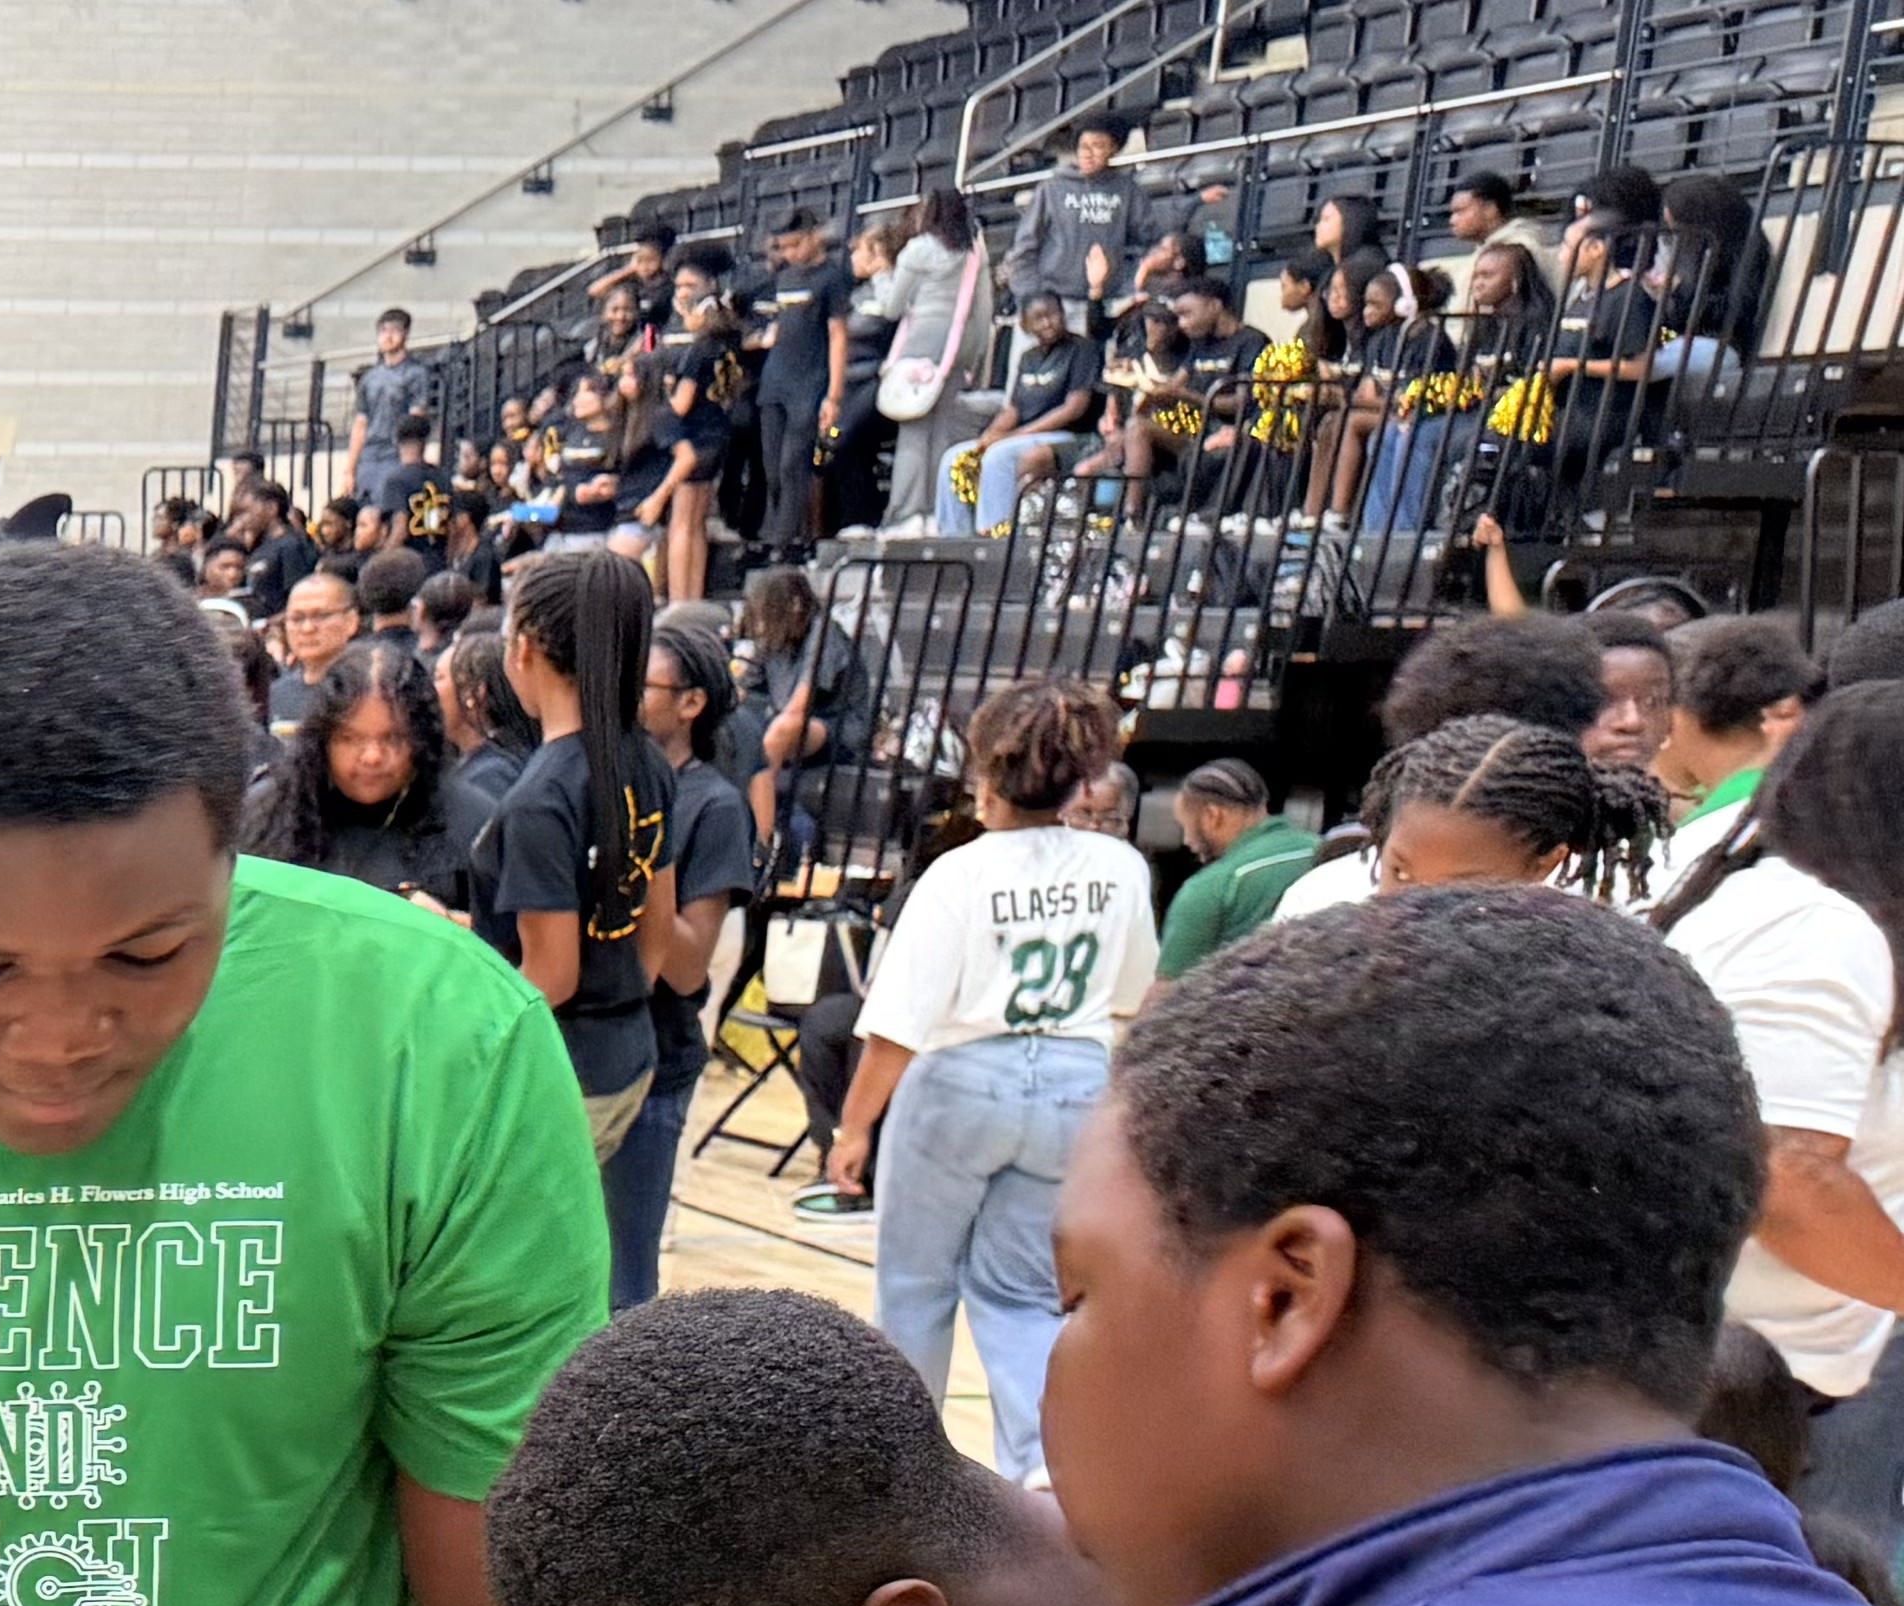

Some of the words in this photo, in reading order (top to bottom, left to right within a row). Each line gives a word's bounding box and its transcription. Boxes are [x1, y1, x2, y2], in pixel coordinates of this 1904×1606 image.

[992, 883, 1077, 924] CLASS
[1088, 881, 1117, 914] OF
[50, 1186, 74, 1205] H.
[80, 1184, 155, 1203] Flowers
[159, 1182, 211, 1205] High
[215, 1181, 284, 1200] School
